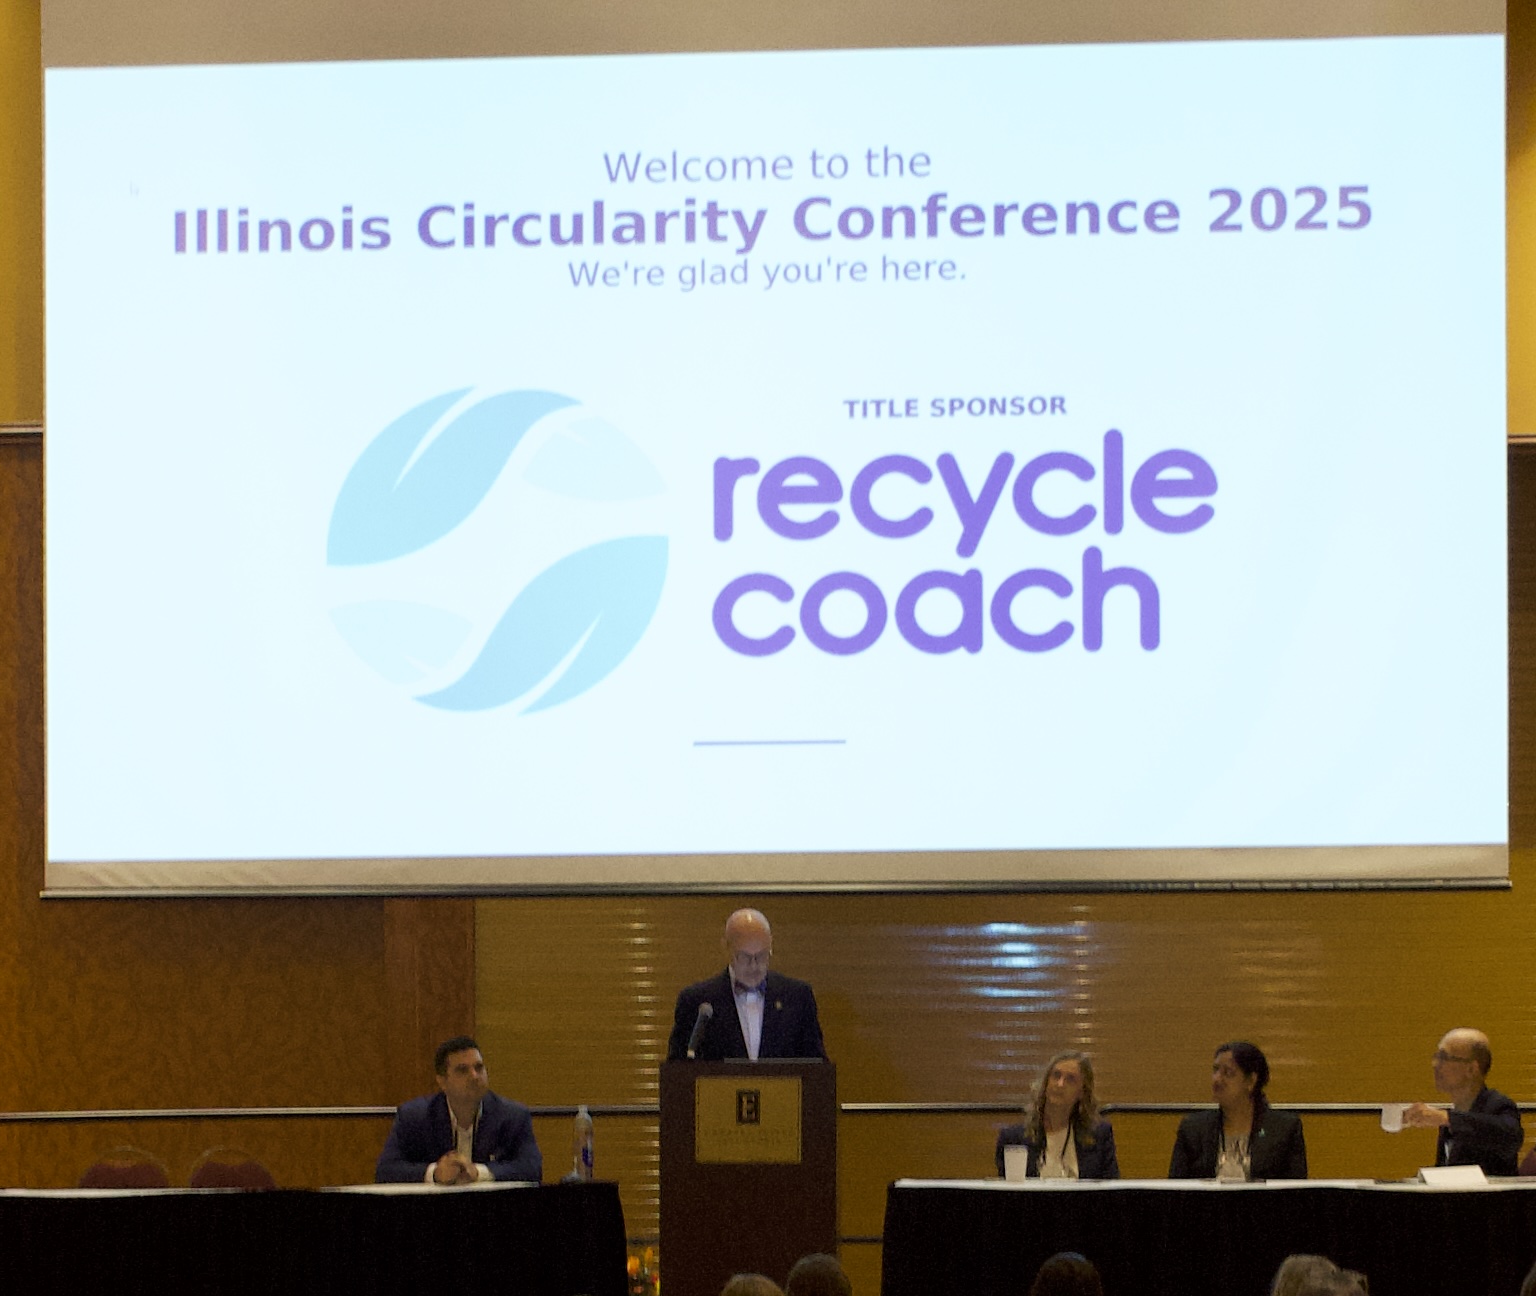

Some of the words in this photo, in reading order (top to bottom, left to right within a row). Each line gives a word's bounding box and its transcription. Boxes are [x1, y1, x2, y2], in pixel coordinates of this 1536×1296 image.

[603, 151, 795, 183] Welcome
[809, 150, 851, 179] to
[864, 146, 933, 178] the
[174, 205, 392, 254] Illinois
[416, 197, 767, 255] Circularity
[793, 192, 1182, 241] Conference
[1209, 185, 1372, 233] 2025
[568, 263, 666, 287] We're
[677, 259, 750, 291] glad
[763, 256, 870, 289] you're
[882, 255, 968, 281] here.
[844, 399, 919, 419] TITLE
[929, 395, 1068, 418] SPONSOR
[713, 429, 1219, 559] recycle
[711, 546, 1162, 658] coach
